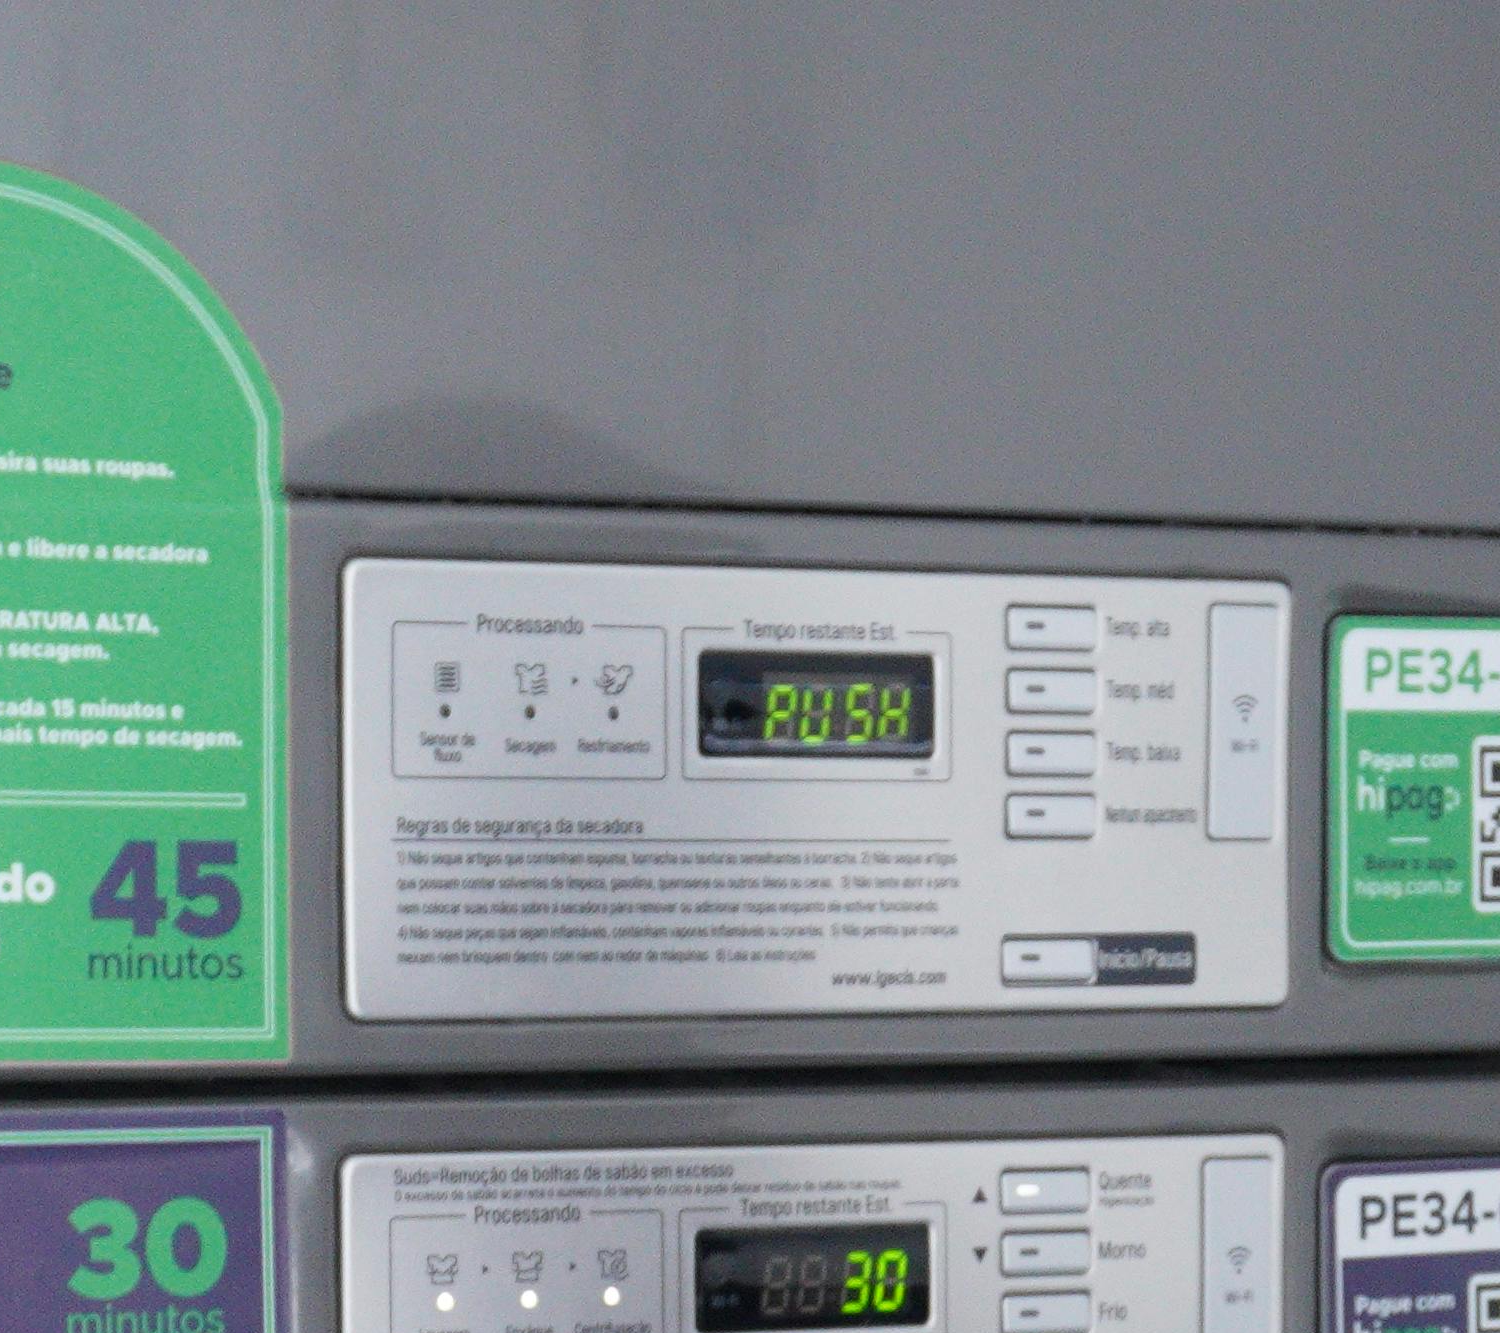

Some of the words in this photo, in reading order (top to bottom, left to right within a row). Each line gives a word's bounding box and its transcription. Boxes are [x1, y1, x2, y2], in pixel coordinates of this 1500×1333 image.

[42, 457, 91, 474] suas
[7, 542, 21, 558] e
[26, 537, 90, 560] libere
[94, 545, 109, 560] a
[113, 543, 209, 563] secadora
[476, 614, 584, 635] Processando
[742, 618, 796, 643] Tempo
[798, 623, 867, 641] restante
[51, 698, 75, 719] 15
[80, 699, 166, 720] minutos
[171, 704, 184, 719] e
[765, 683, 910, 748] PUSH
[38, 726, 108, 748] tempo
[113, 727, 140, 746] de
[90, 840, 242, 939] 45
[87, 944, 245, 981] minutos
[474, 1203, 581, 1224] Processando
[739, 1198, 791, 1220] Tempo
[69, 1198, 226, 1298] 30
[843, 1249, 908, 1312] 30
